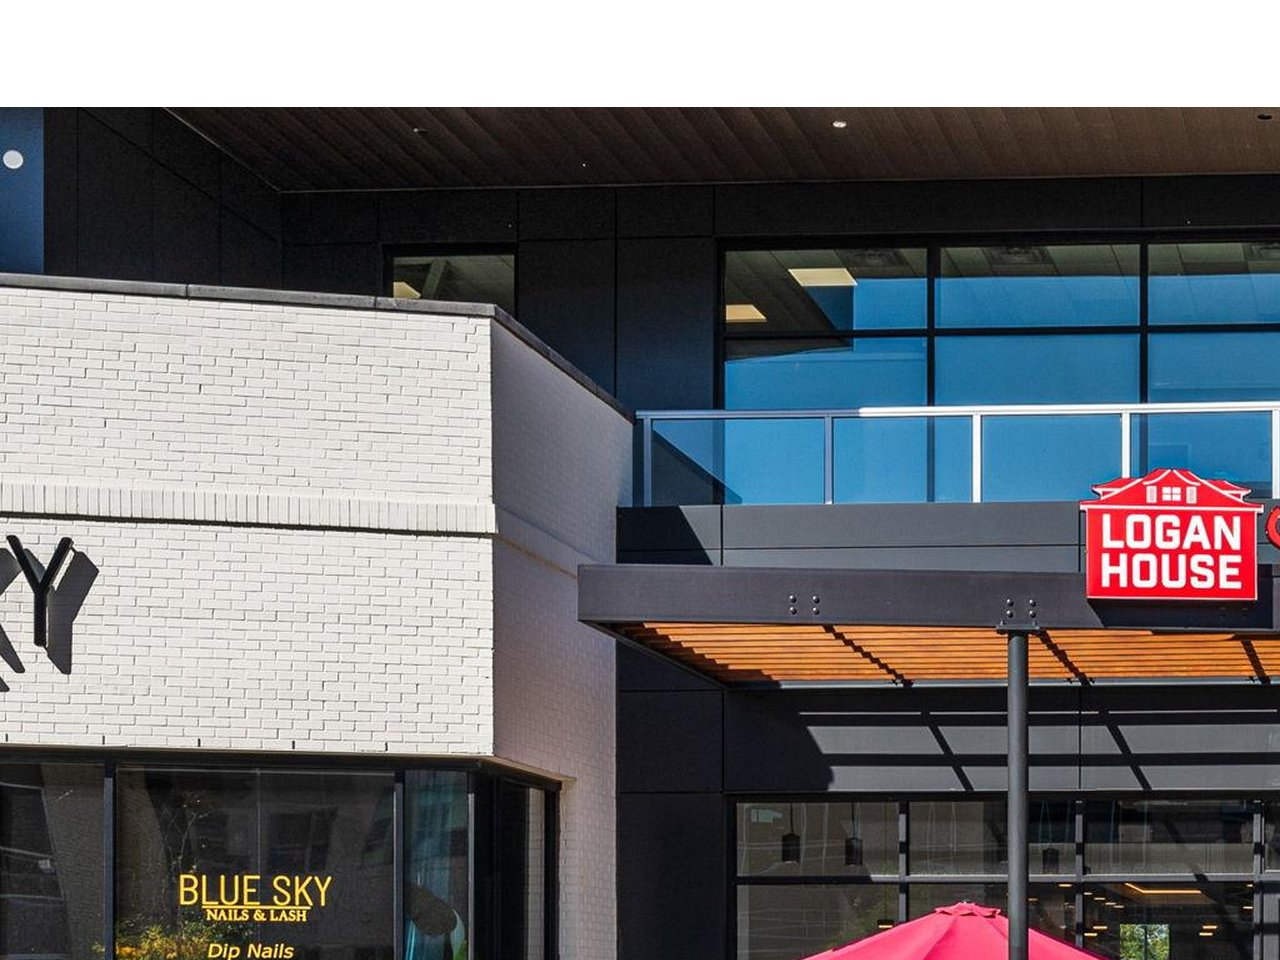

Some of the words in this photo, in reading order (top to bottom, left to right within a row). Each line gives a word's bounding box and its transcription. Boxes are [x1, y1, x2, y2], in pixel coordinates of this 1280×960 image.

[1102, 514, 1241, 549] LOGAN
[1101, 553, 1242, 590] HOUSE
[179, 874, 261, 906] BLUE
[273, 874, 332, 906] SKY
[206, 909, 249, 921] NAILS
[253, 909, 266, 921] &
[269, 909, 307, 921] LASH
[207, 943, 240, 960] Dip
[247, 943, 294, 959] Nails
